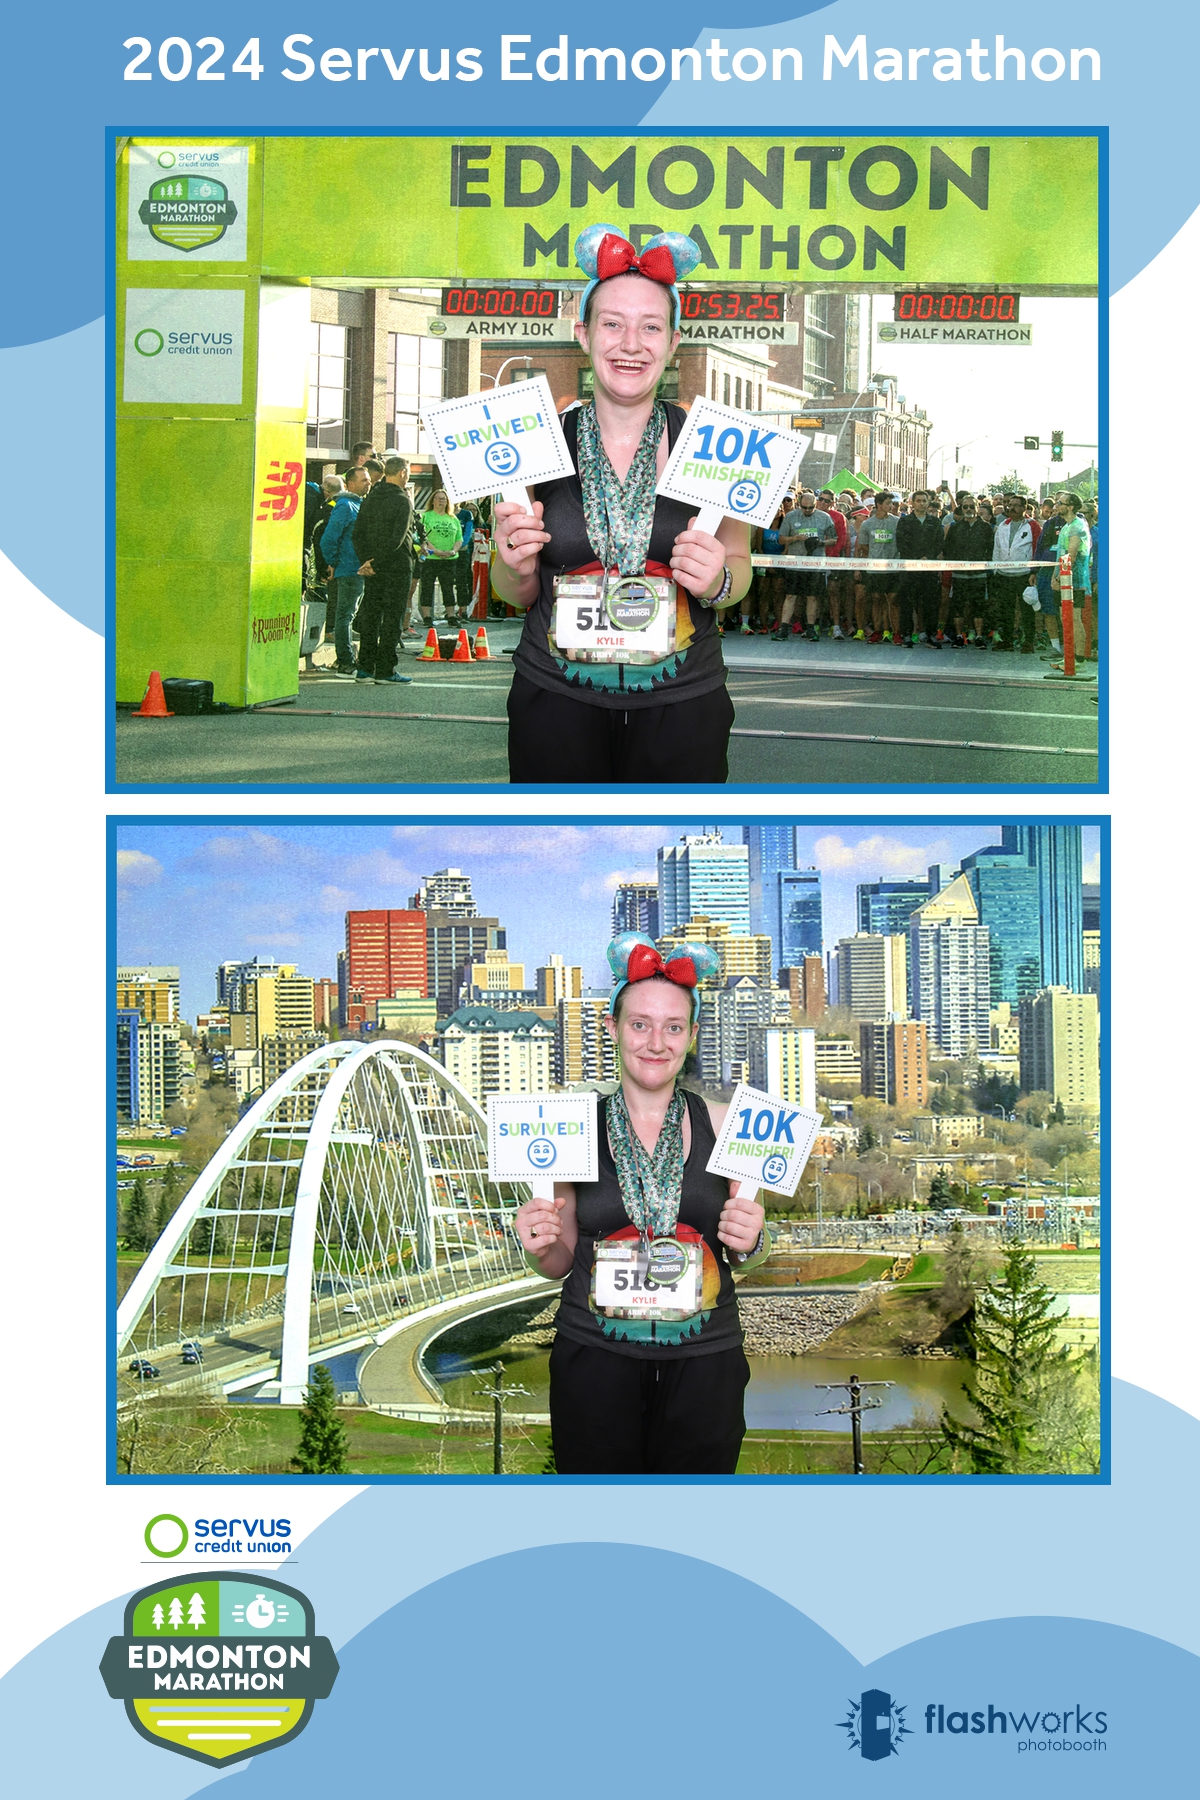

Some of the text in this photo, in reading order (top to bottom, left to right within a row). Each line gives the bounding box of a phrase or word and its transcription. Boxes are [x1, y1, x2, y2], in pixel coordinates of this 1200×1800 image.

[179, 152, 219, 162] servus
[450, 145, 990, 211] EDMONTON
[150, 203, 227, 215] EDMONTON
[160, 213, 216, 222] MARATHON
[523, 222, 906, 271] MRATHON
[466, 321, 554, 336] ARMY 10K
[680, 325, 785, 340] MARATHON
[900, 327, 939, 339] HALF
[942, 328, 1031, 341] MARATHON
[168, 331, 233, 345] servus
[168, 344, 233, 355] credit union
[483, 405, 492, 420] I
[444, 412, 545, 451] SURVIVED!
[693, 424, 779, 469] 10K
[682, 461, 771, 487] FINISHER!
[597, 637, 625, 646] KYLIE
[591, 651, 630, 659] ARMY 10K
[538, 1105, 543, 1118] I
[499, 1121, 585, 1137] SURVIVED!
[736, 1108, 800, 1144] 10K
[727, 1141, 795, 1160] FINISHER!
[632, 1297, 658, 1305] KYLIE
